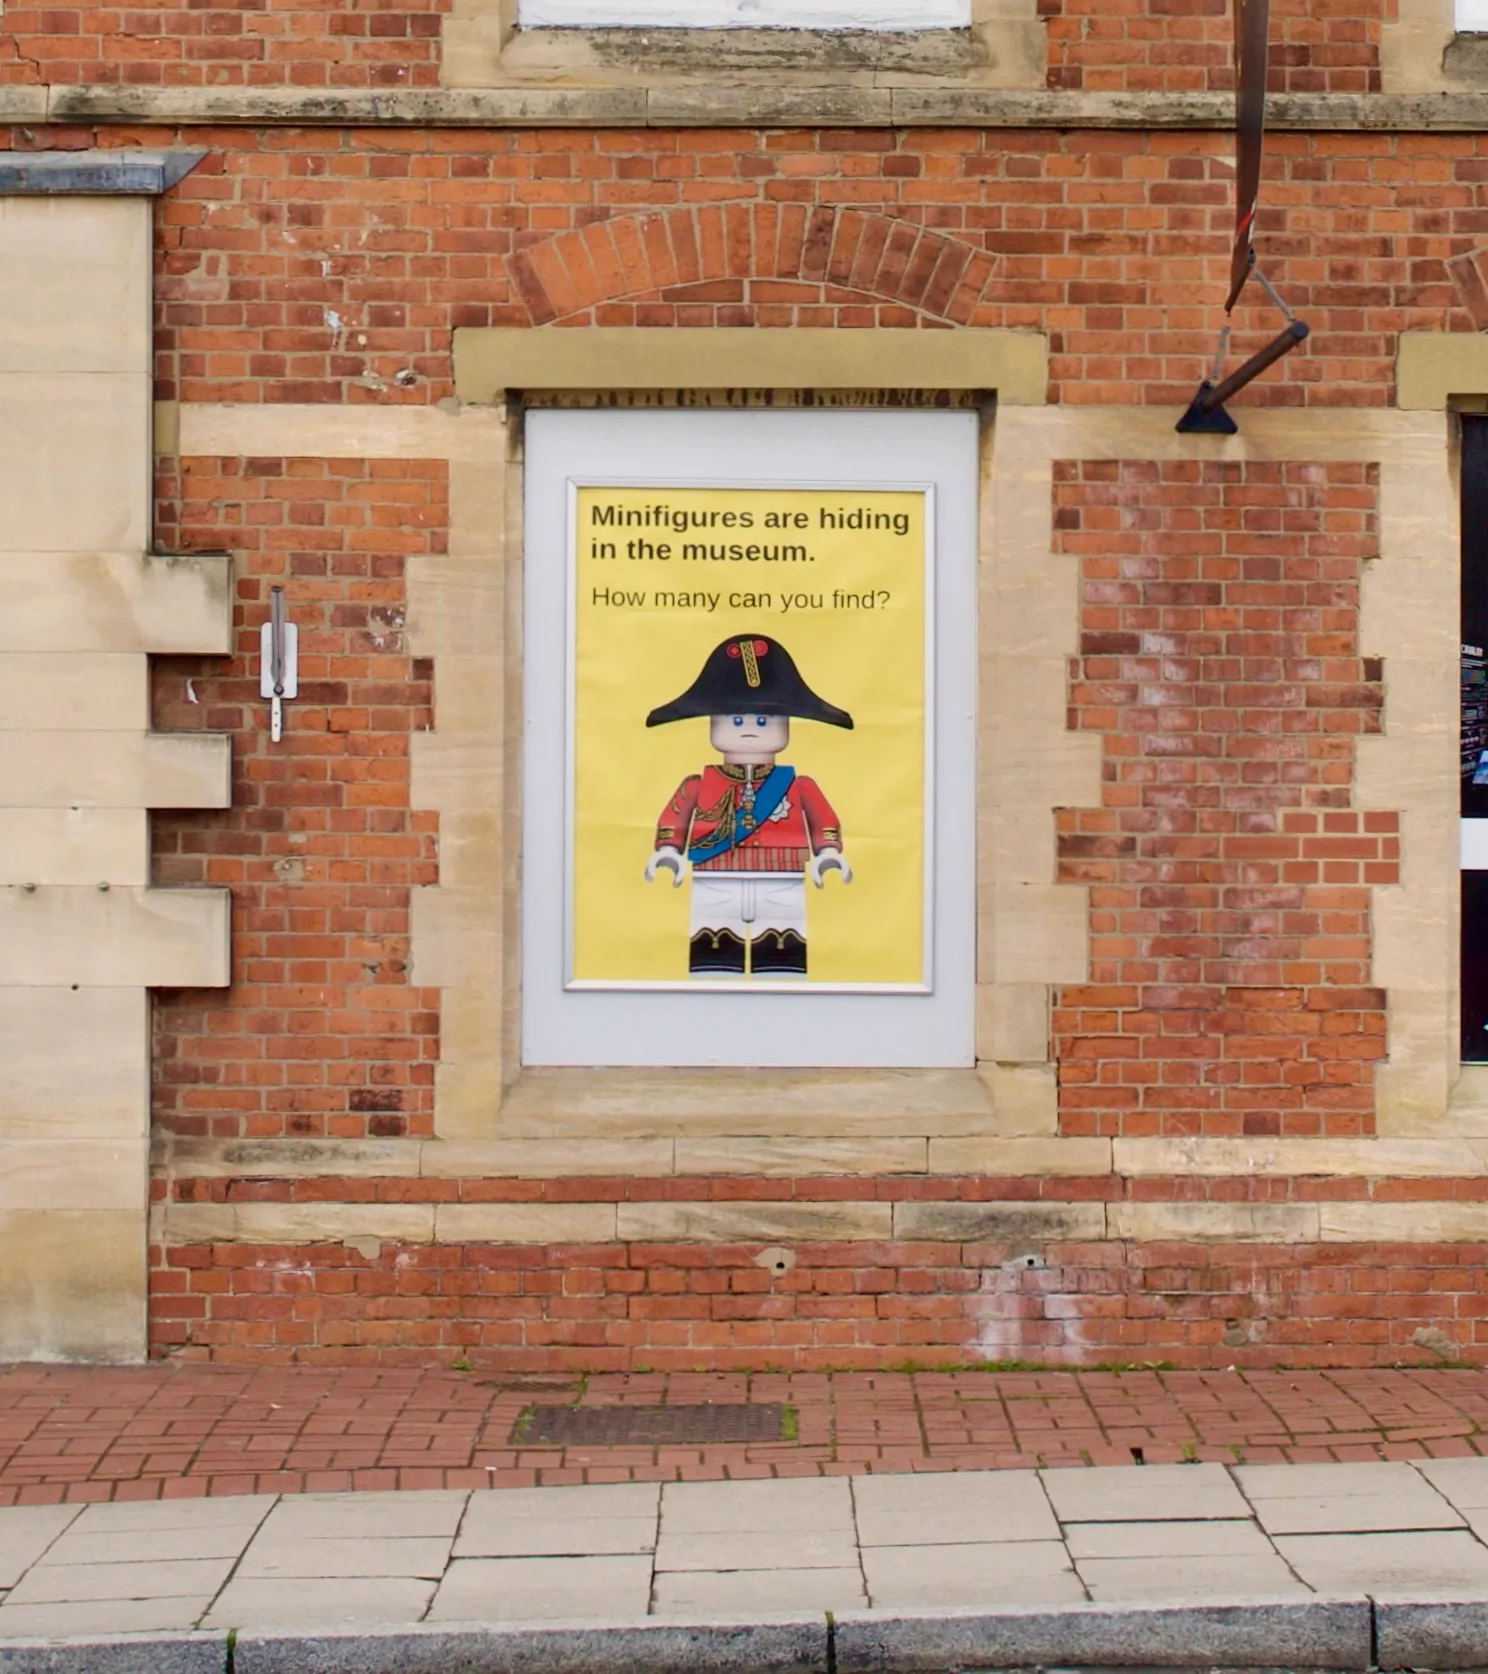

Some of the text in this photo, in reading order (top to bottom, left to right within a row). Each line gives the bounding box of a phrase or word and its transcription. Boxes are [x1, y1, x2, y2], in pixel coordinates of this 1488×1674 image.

[591, 505, 910, 536] Minifigures are hiding
[591, 537, 816, 562] in the museum.
[592, 587, 891, 613] How many can you find?
